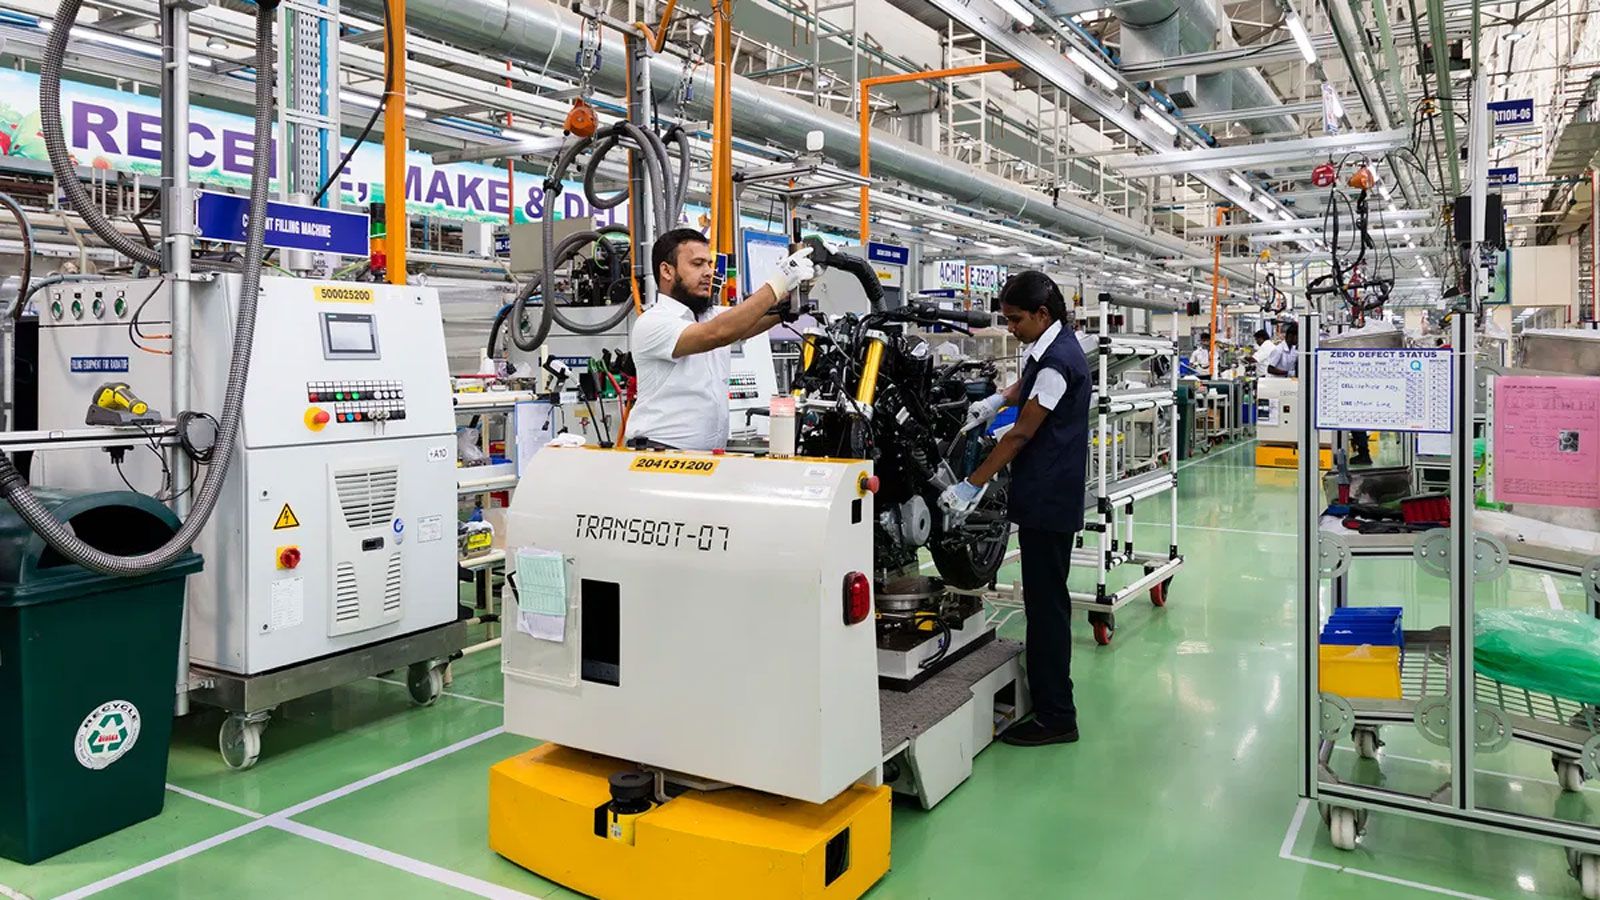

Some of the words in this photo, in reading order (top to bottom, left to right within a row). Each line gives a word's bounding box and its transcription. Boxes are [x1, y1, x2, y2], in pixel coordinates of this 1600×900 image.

[275, 218, 299, 234] FILLING
[301, 221, 331, 238] MACHINE
[940, 262, 974, 285] ACHIEE
[321, 288, 370, 300] 500025200
[635, 458, 714, 471] 204131200
[576, 514, 729, 551] TRANSBOT-07
[84, 703, 138, 728] RECYCLE
